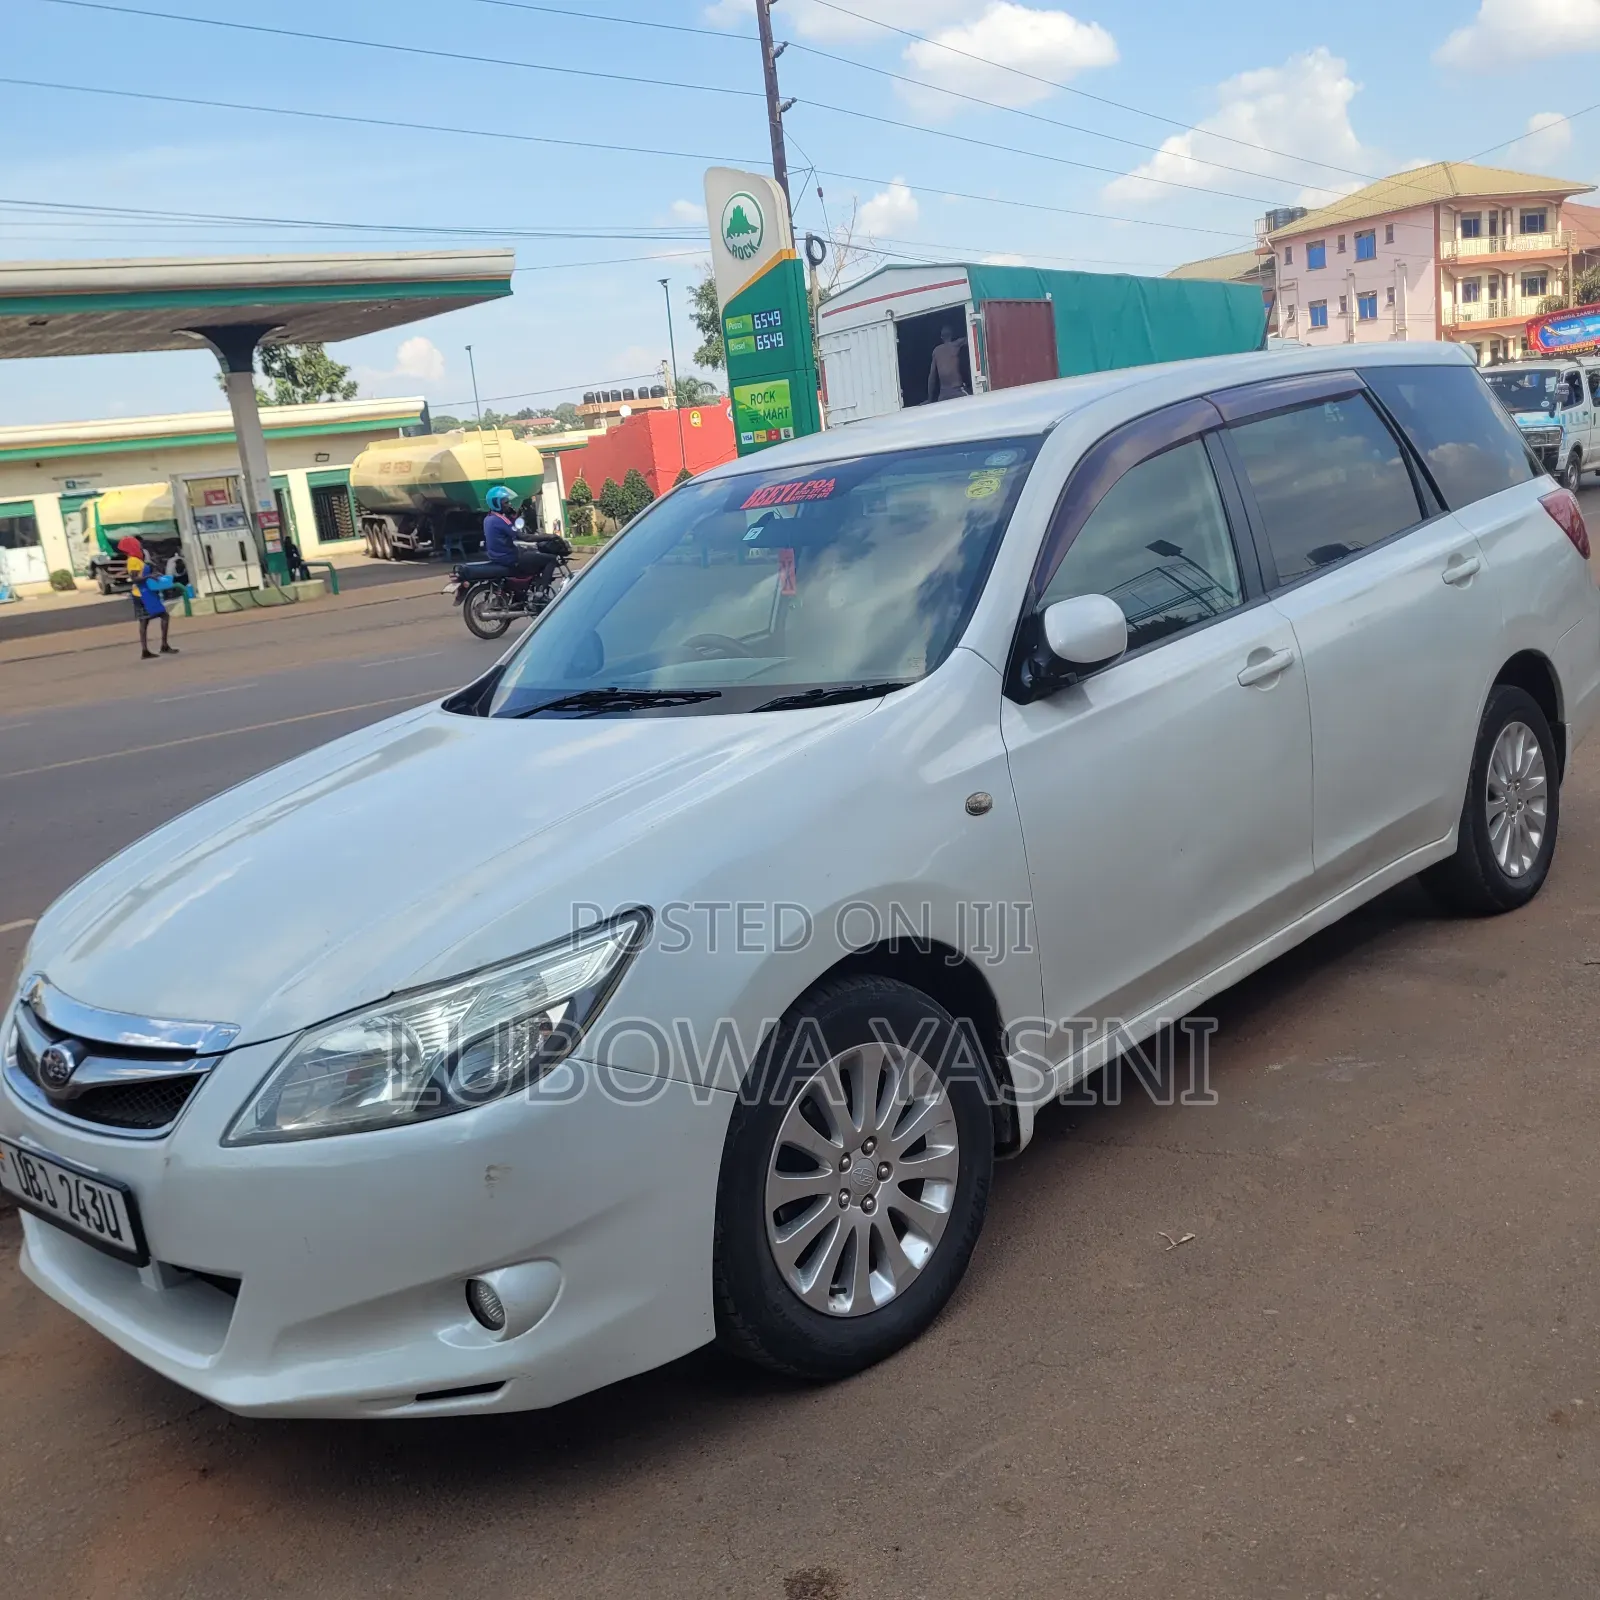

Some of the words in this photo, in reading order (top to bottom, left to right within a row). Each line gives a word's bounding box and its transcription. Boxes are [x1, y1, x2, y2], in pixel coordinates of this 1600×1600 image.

[731, 239, 759, 260] ROCK
[728, 321, 743, 331] Petrol
[754, 310, 781, 330] 6549
[731, 342, 746, 352] Diesel
[756, 332, 784, 350] 6549
[750, 390, 776, 406] ROCK
[763, 406, 789, 421] MART
[9, 1150, 58, 1210] UBJ
[58, 1173, 124, 1242] 243U
